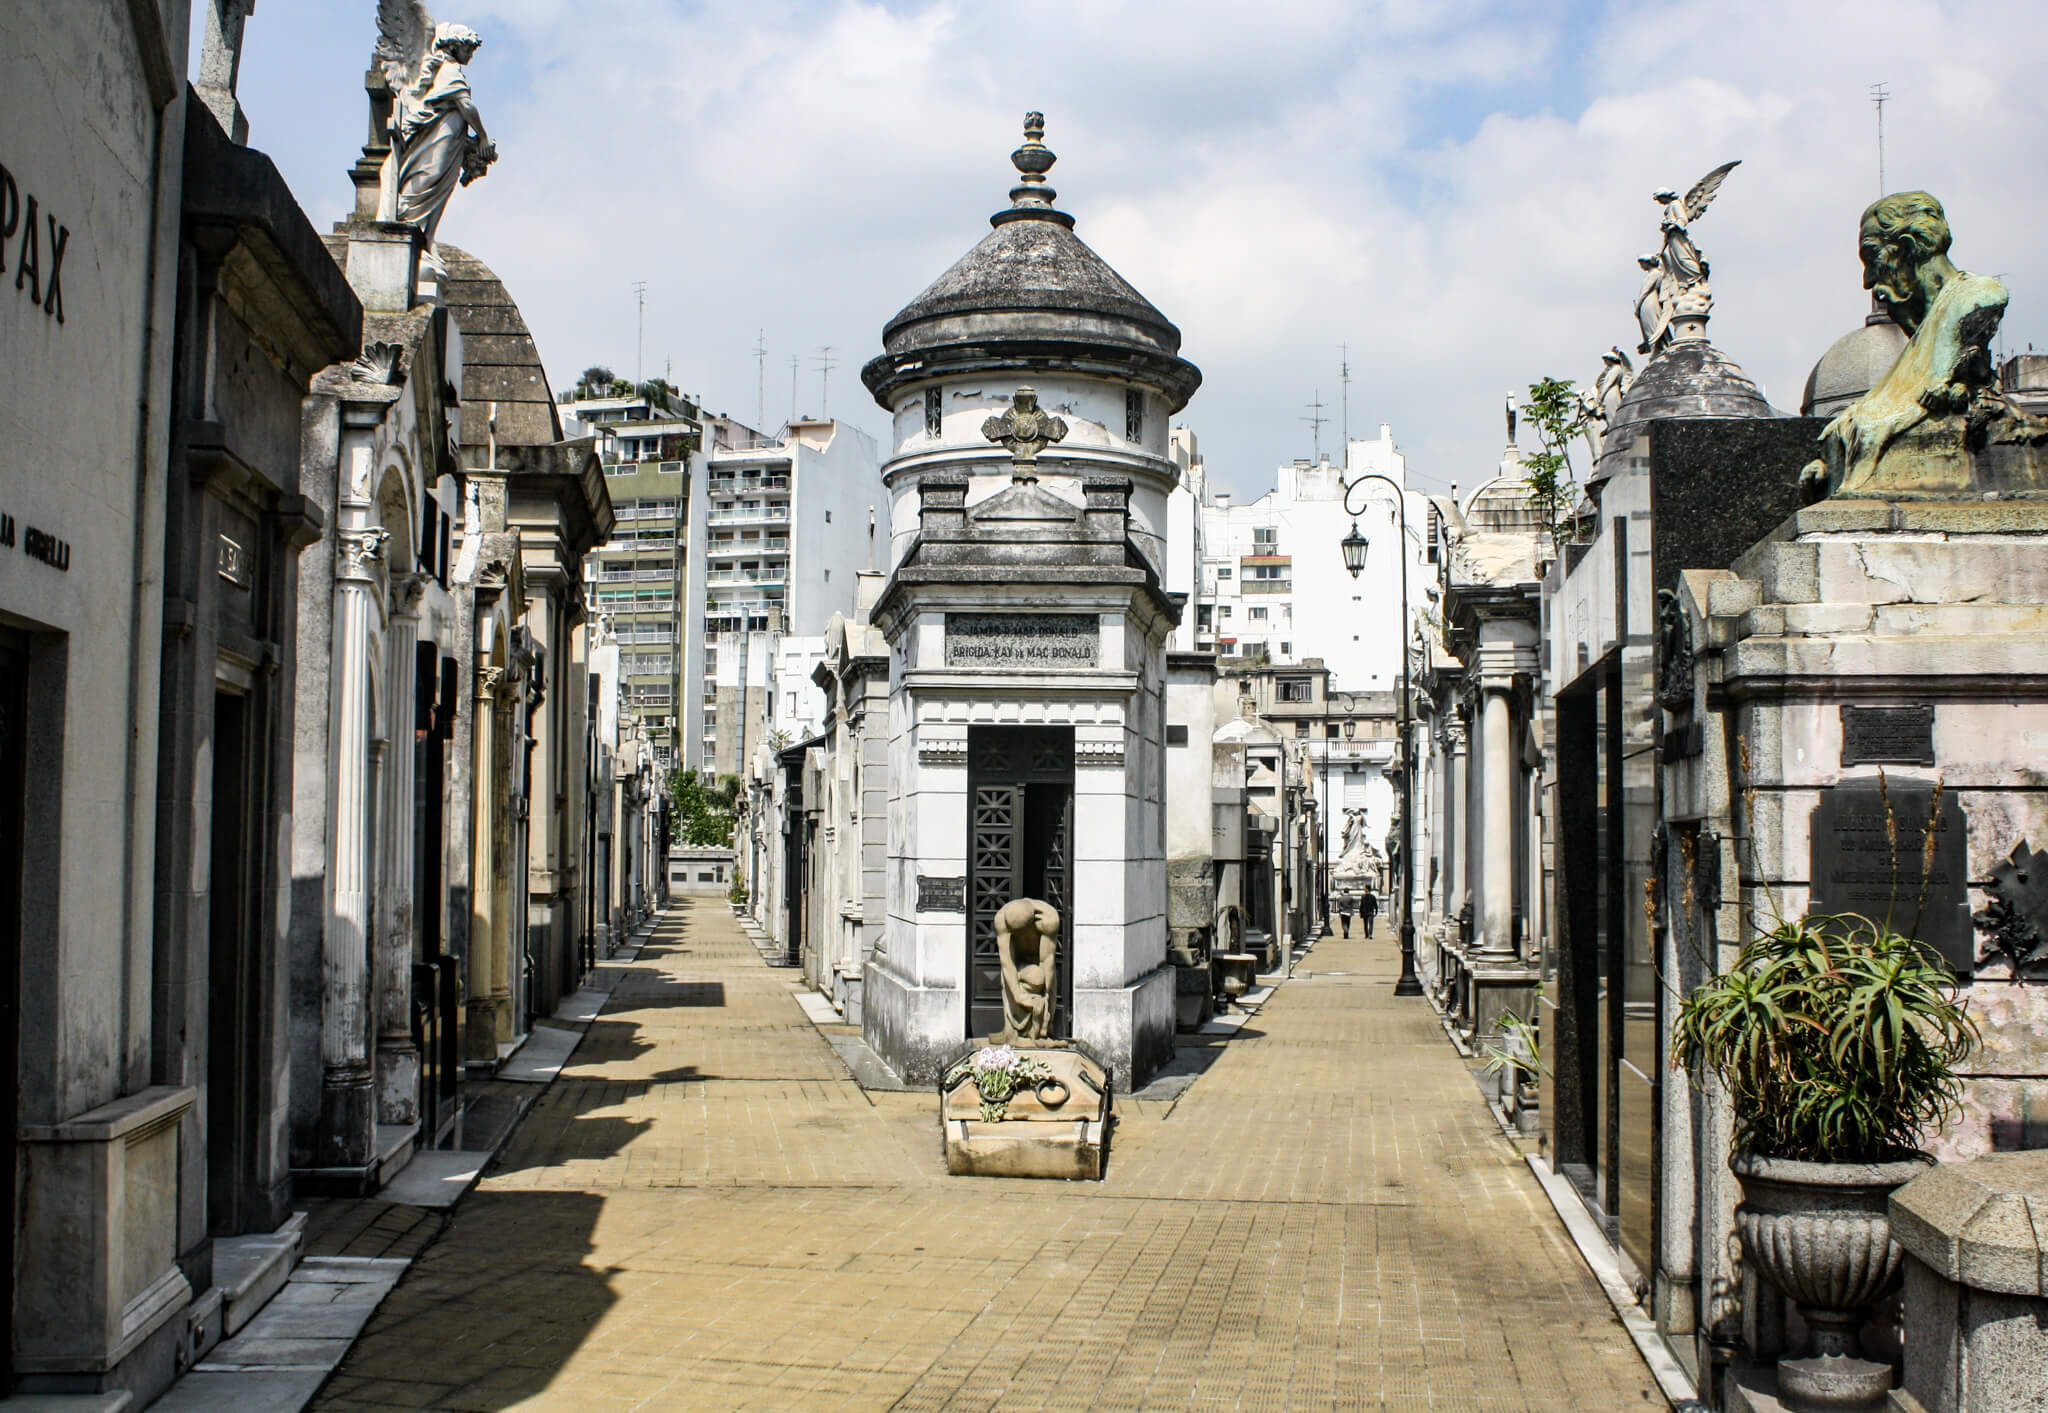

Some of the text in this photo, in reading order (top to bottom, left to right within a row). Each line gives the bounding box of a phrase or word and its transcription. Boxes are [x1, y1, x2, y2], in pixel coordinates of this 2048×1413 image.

[0, 164, 70, 324] PAX
[970, 625, 1000, 638] JAMES
[1038, 625, 1078, 638] DONALD
[953, 646, 990, 658] BRIGIDA
[993, 646, 1013, 658] KAY
[1027, 646, 1049, 658] MAC
[1052, 647, 1091, 659] DONALD
